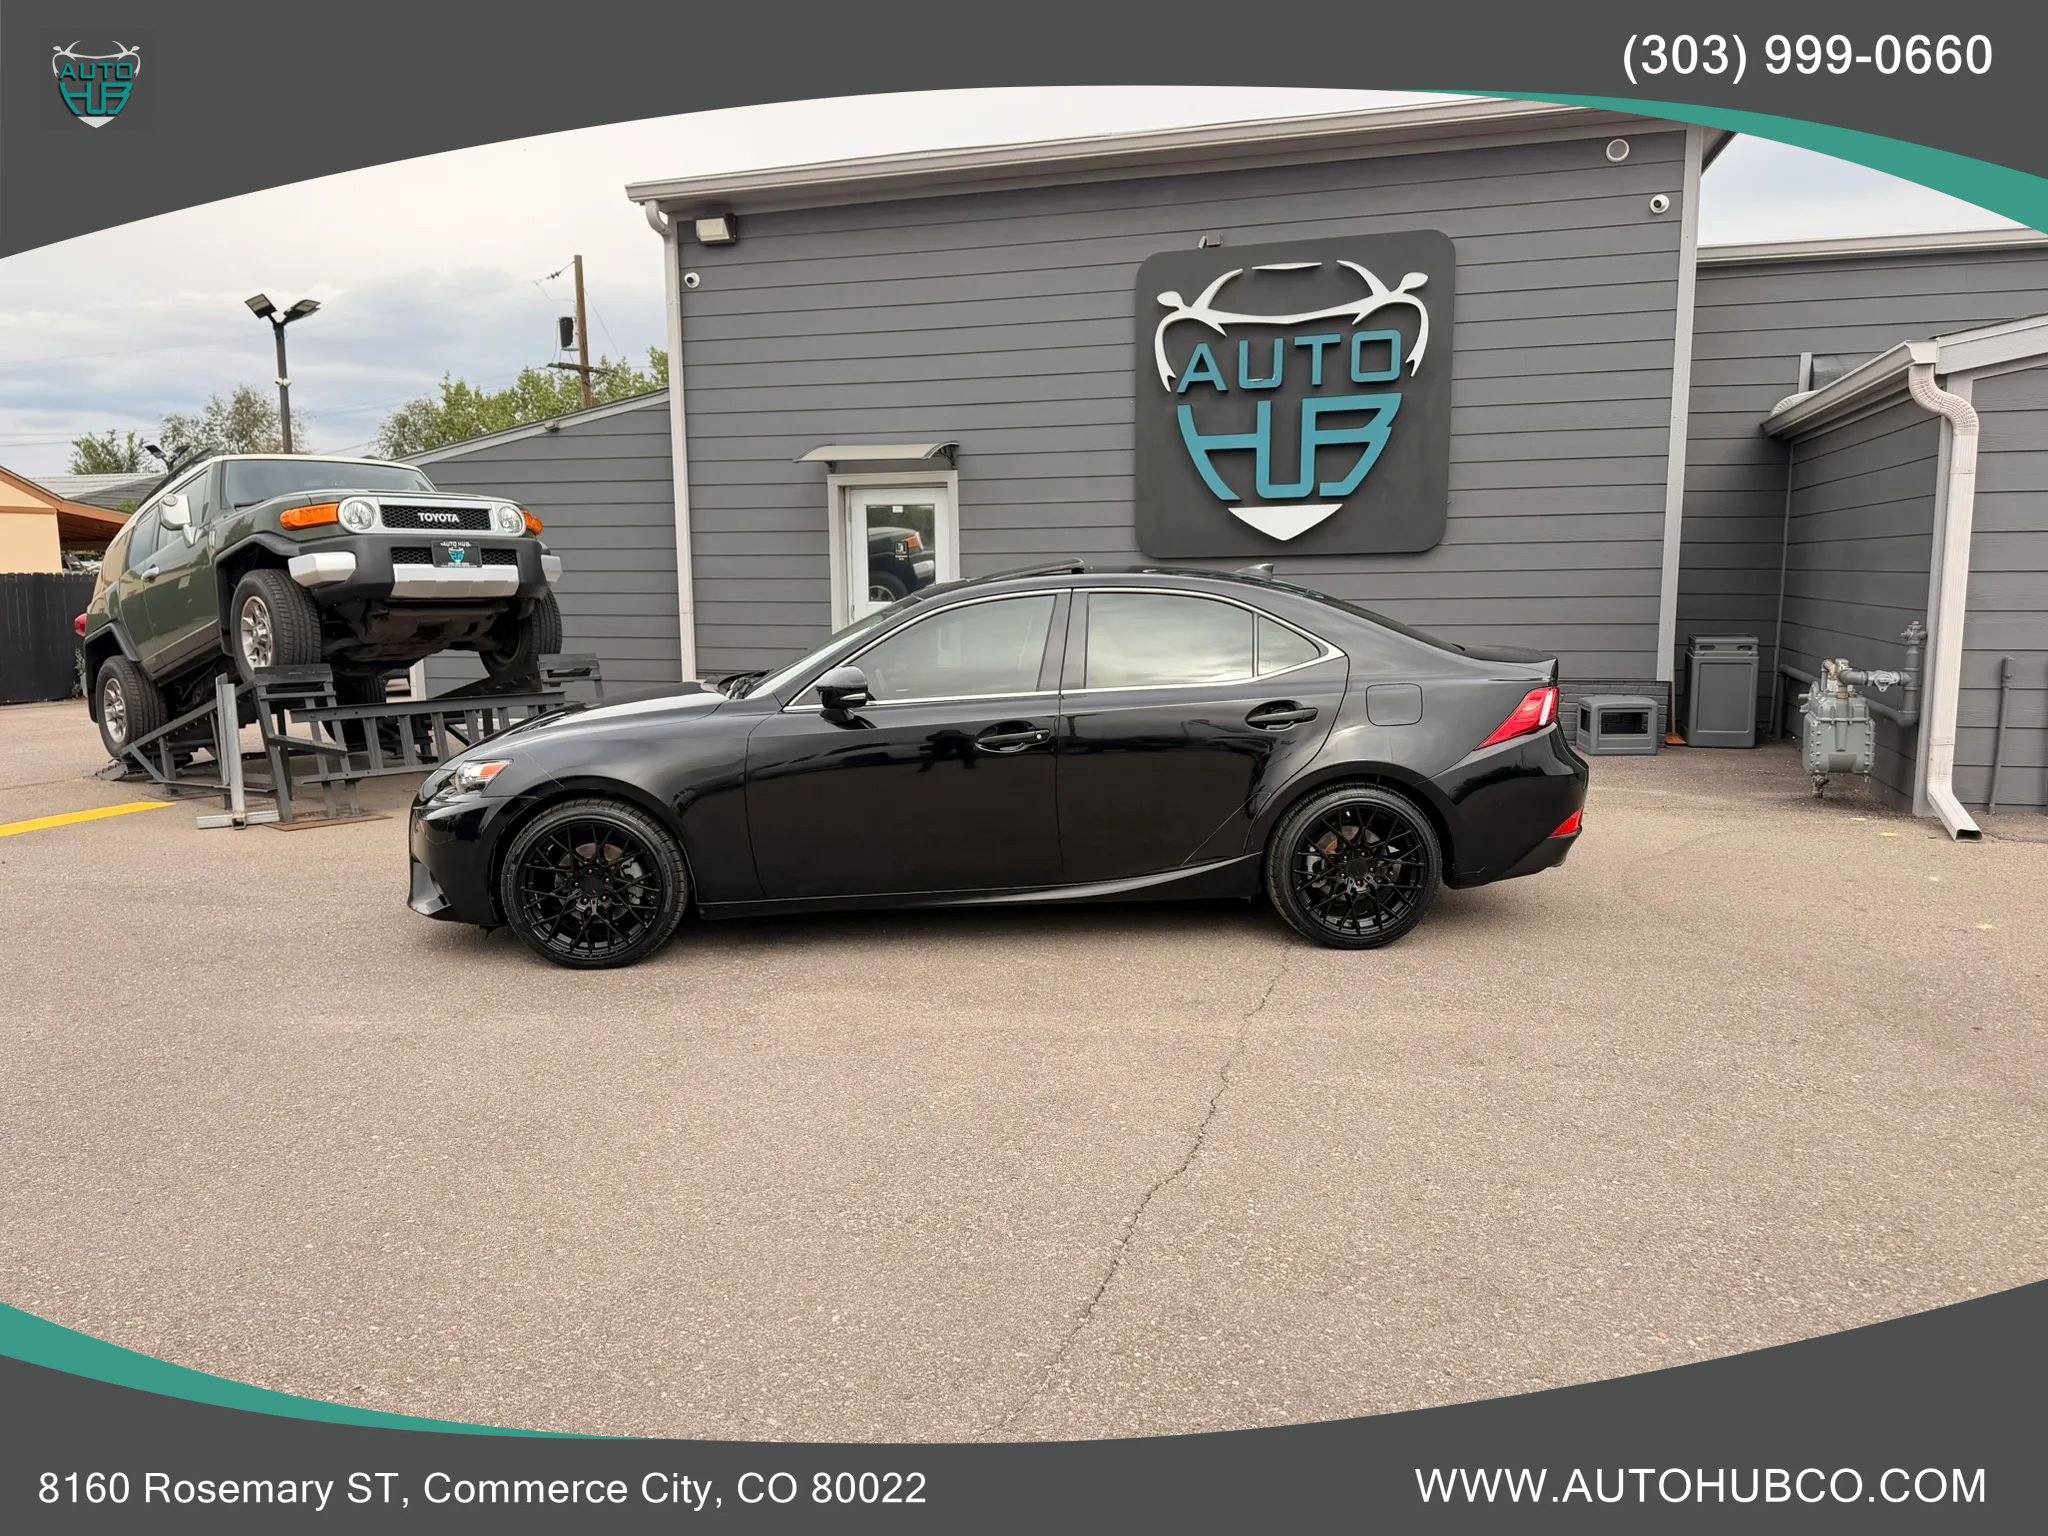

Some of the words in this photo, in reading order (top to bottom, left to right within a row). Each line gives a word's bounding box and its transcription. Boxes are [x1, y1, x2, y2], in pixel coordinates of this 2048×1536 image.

[1176, 329, 1402, 393] AUTO
[1176, 392, 1403, 501] HUB
[417, 512, 460, 523] TOYOTA
